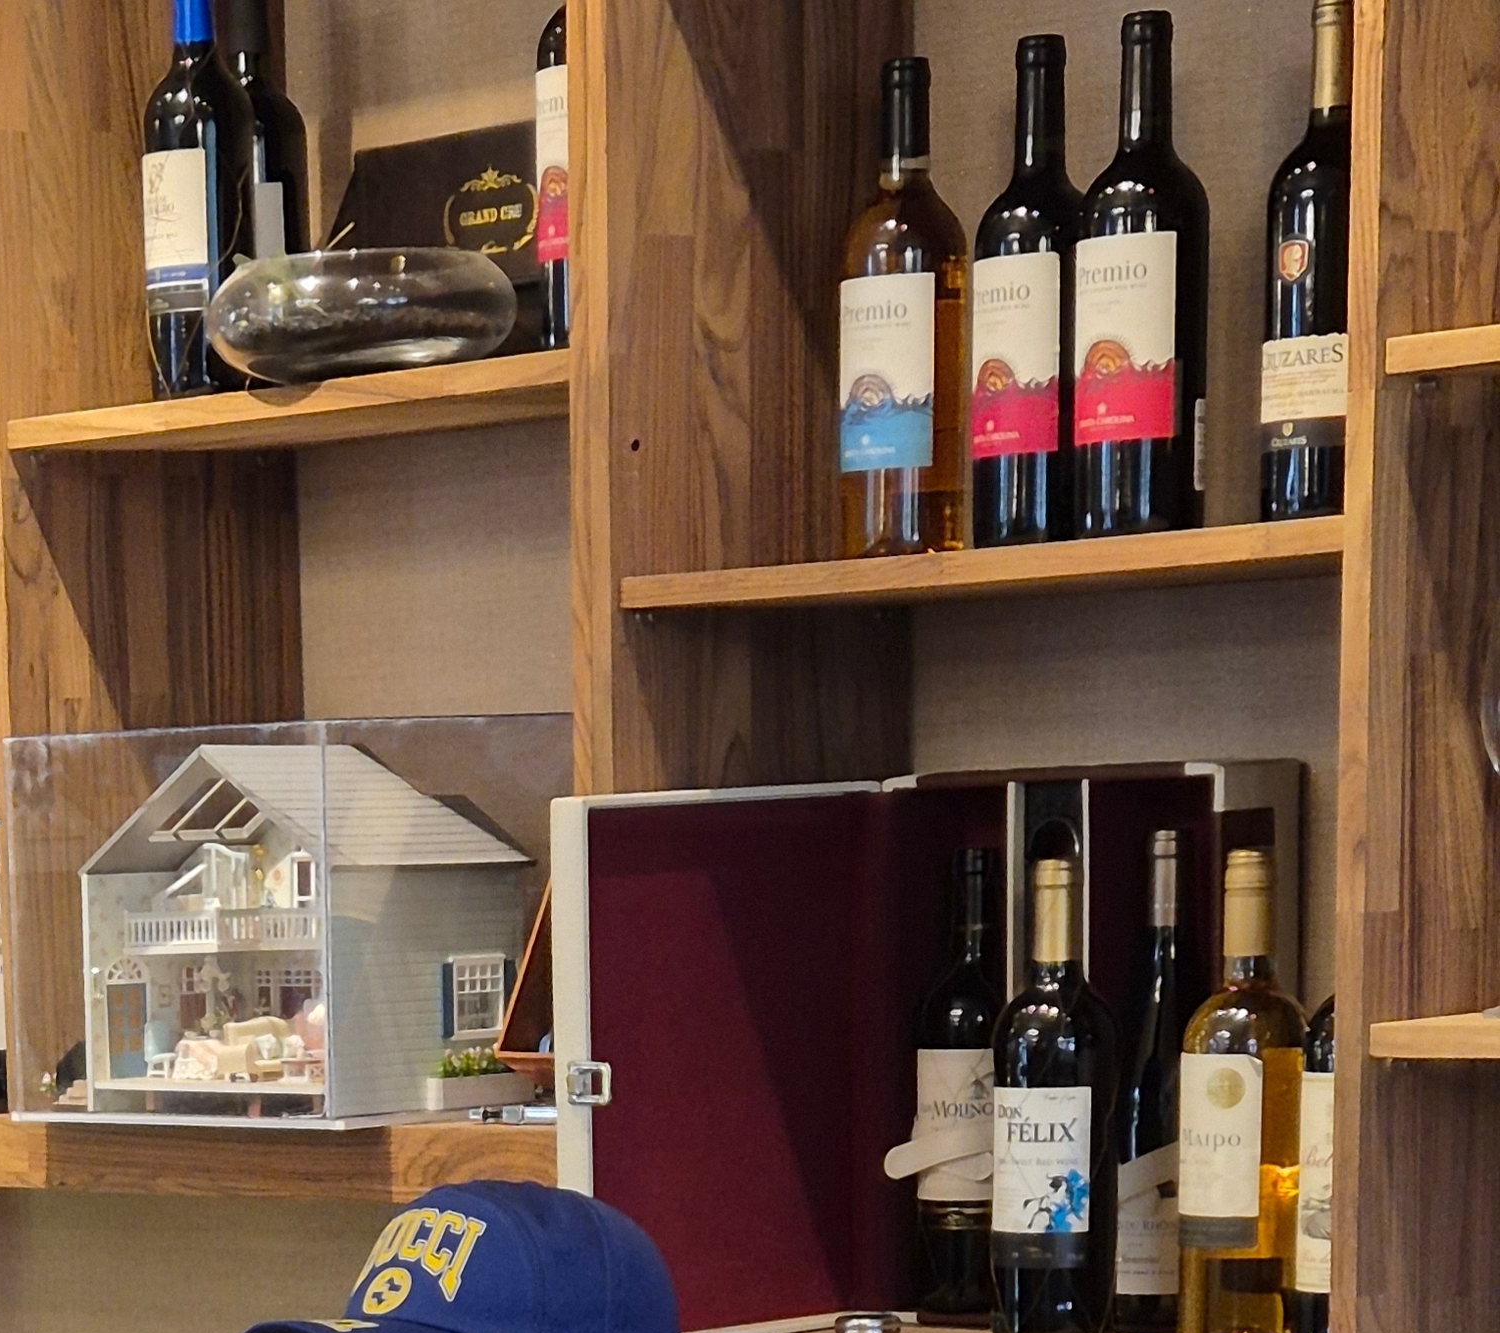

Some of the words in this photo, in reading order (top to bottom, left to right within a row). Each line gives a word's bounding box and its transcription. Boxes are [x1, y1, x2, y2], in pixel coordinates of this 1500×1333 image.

[459, 207, 498, 227] GRAND
[998, 1104, 1022, 1119] DON
[1006, 1116, 1077, 1143] FÉLIX
